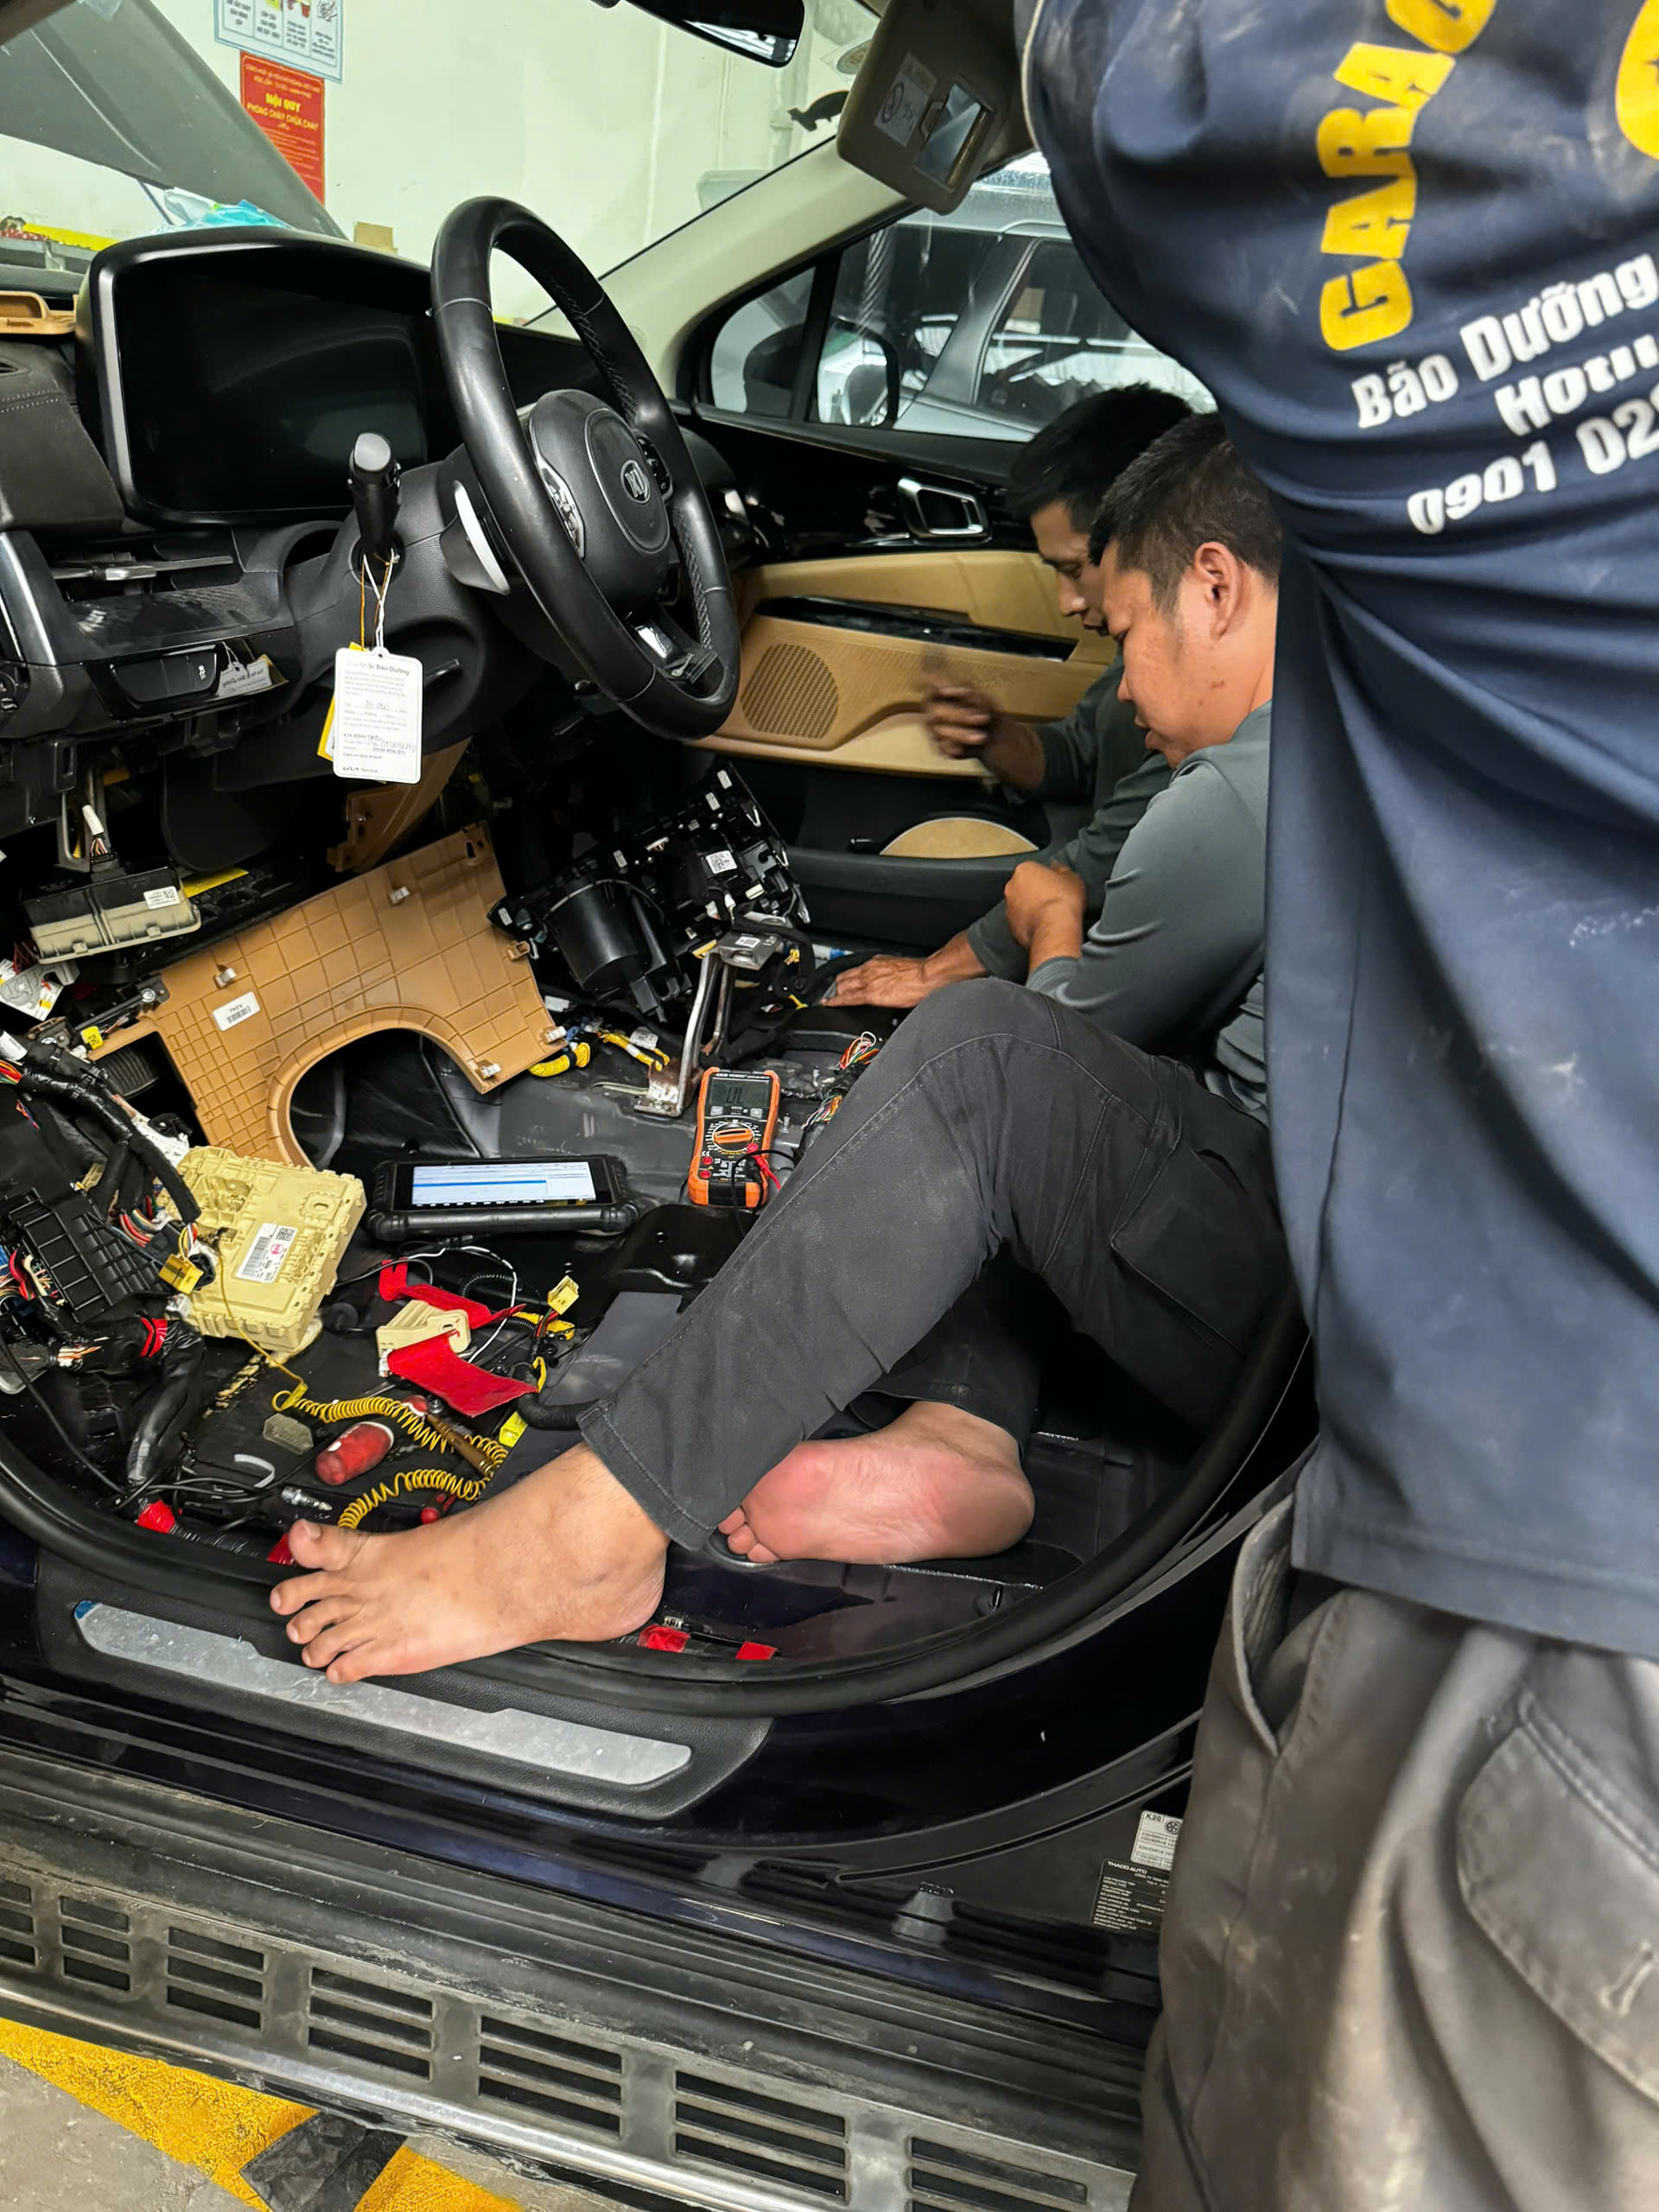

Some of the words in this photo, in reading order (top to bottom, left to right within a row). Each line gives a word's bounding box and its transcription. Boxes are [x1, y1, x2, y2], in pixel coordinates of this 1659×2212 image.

[1459, 252, 1659, 382] Dưỡng
[1407, 441, 1556, 535] 0901
[1576, 381, 1659, 474] 02
[1145, 1814, 1162, 1822] K20
[1107, 1860, 1130, 1871] THACO
